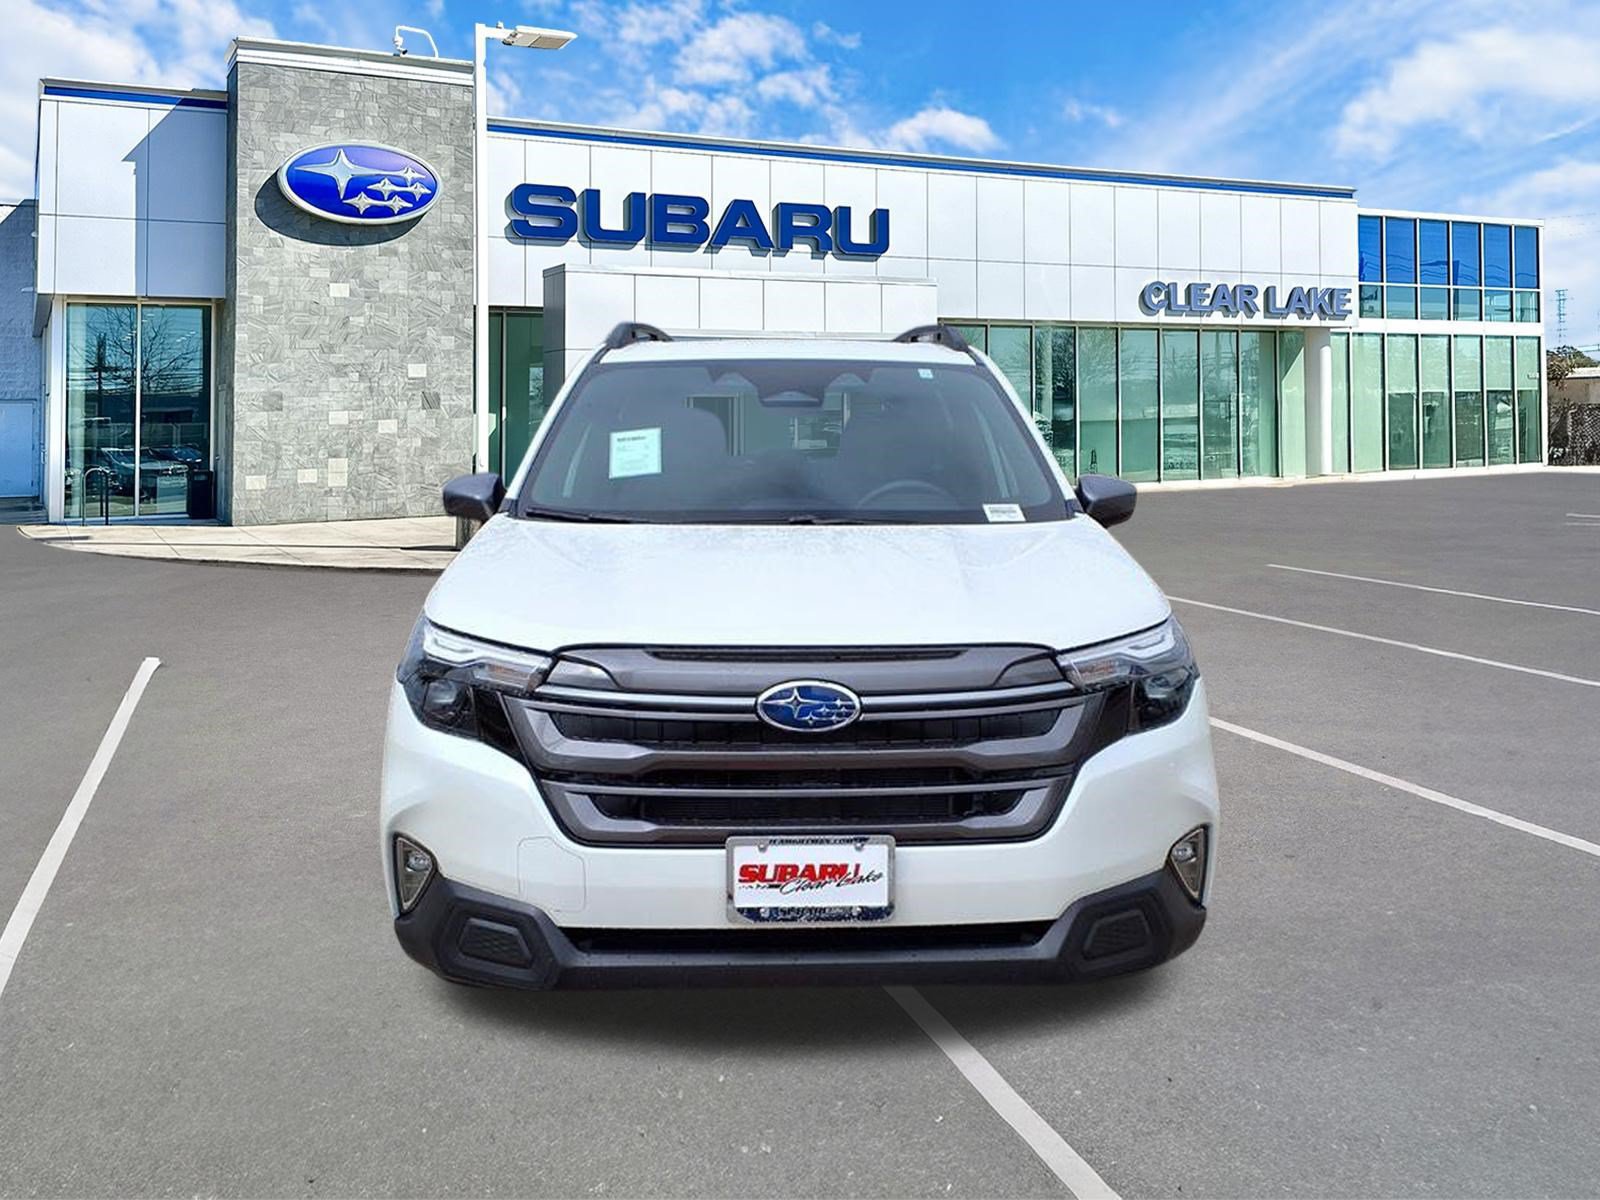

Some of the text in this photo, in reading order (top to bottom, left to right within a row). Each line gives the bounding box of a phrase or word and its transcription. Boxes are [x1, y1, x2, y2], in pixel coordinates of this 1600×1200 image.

[505, 183, 890, 261] SUBARU
[1139, 280, 1353, 321] CLEAR LAKE
[738, 863, 861, 883] SUBARU
[779, 869, 883, 895] Clear Lake
